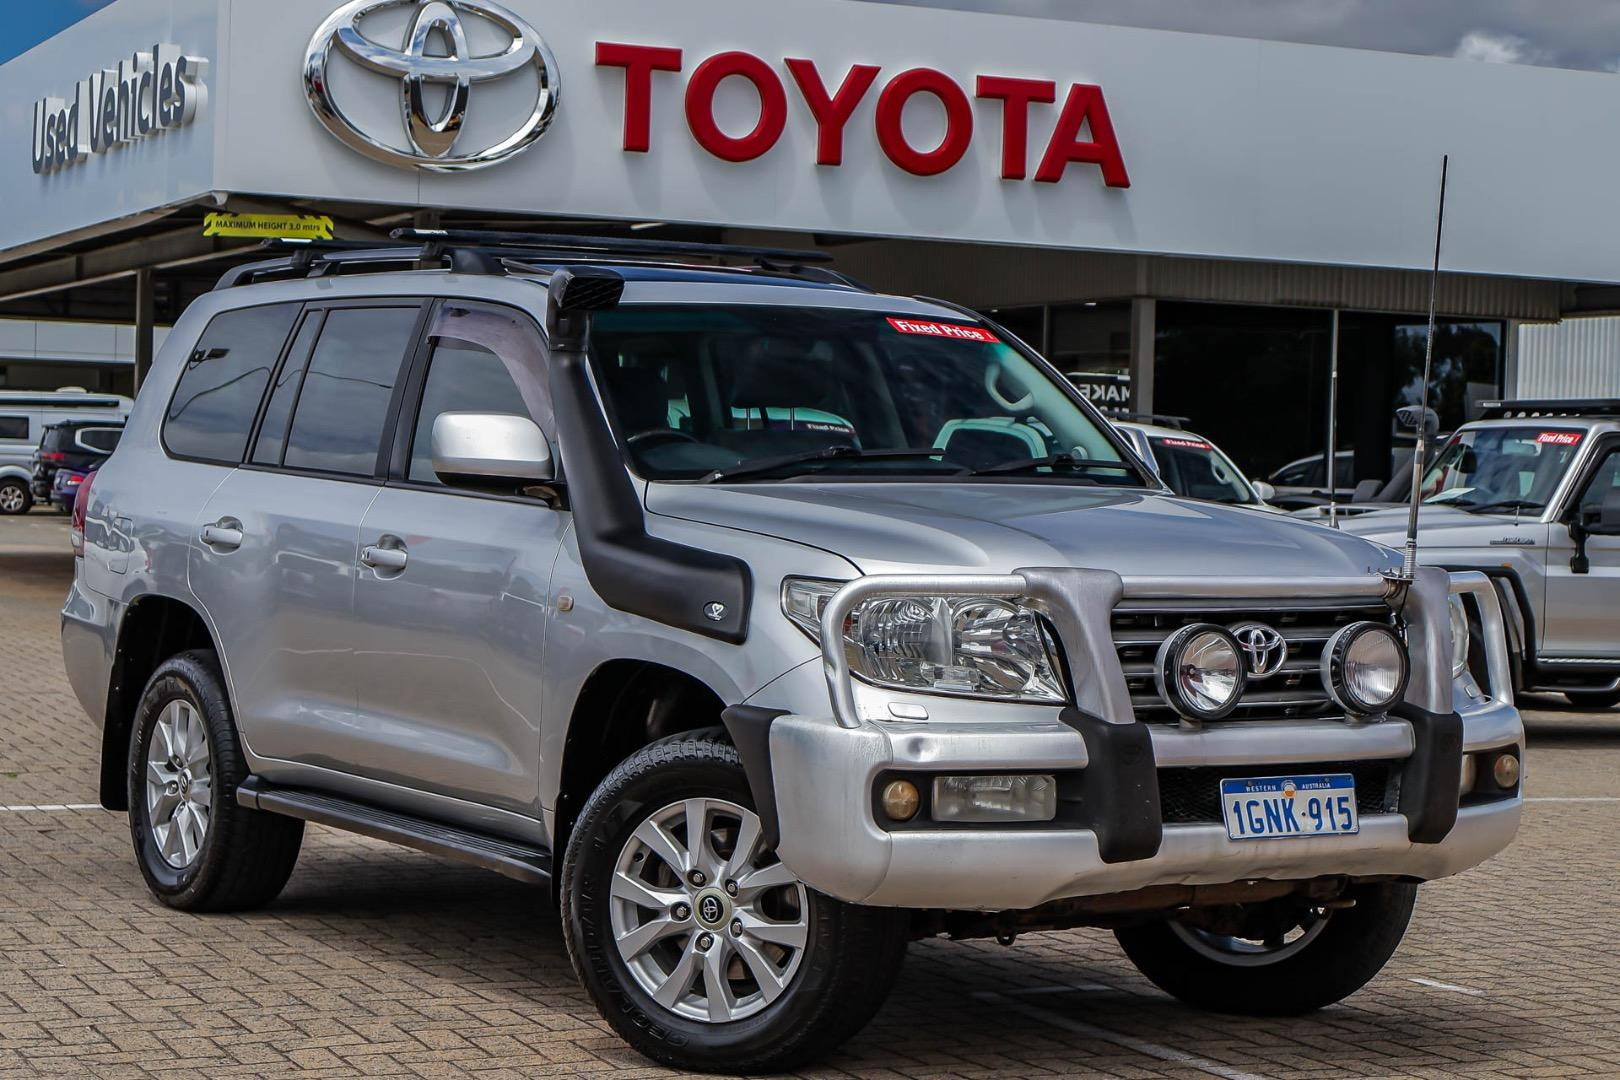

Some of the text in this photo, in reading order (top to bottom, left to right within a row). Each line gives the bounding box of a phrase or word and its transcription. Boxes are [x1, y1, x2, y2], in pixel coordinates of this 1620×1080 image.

[32, 43, 188, 174] Used Vehicles
[595, 41, 1131, 188] TOYOTA
[215, 220, 320, 232] MAXIMUM HEIGHT 3.0 mtrs
[894, 320, 984, 340] Fixed Price
[1538, 433, 1574, 444] Fixed Price
[1246, 782, 1331, 793] WESTERN AUSTRALIA
